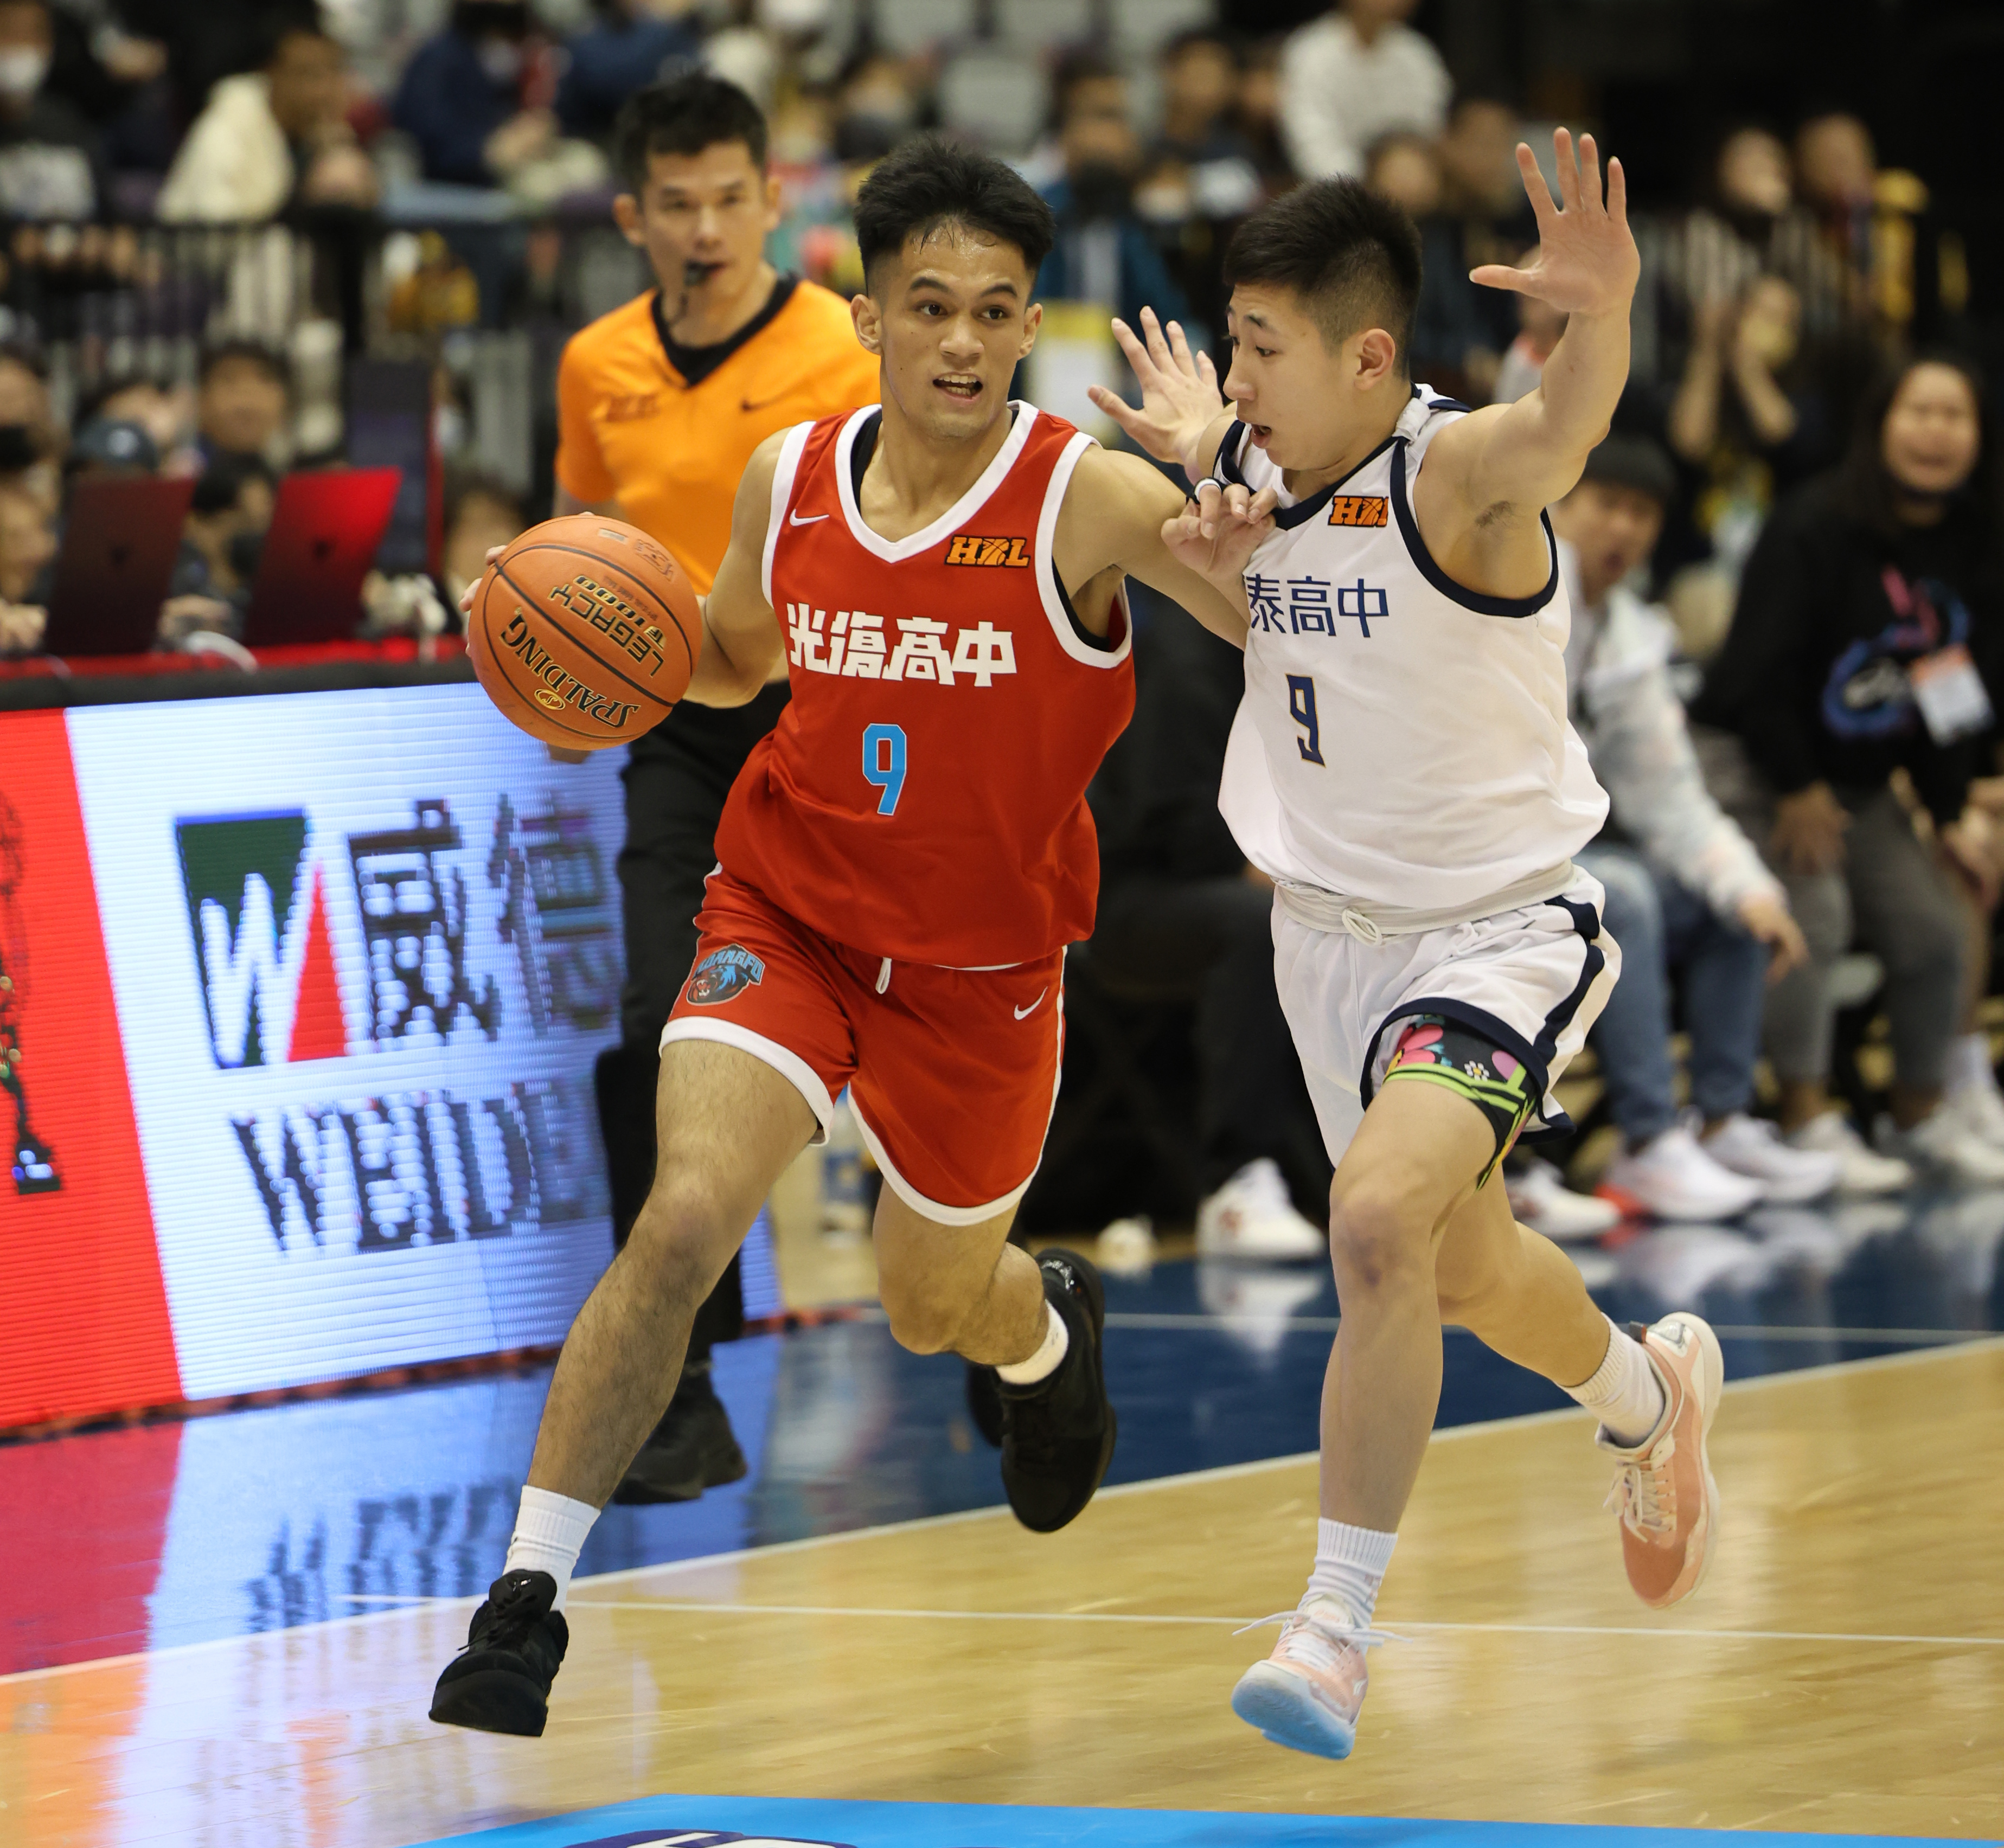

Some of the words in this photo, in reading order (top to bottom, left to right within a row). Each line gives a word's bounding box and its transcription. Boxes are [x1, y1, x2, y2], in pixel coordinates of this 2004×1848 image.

[945, 534, 1031, 568] HBL
[547, 584, 665, 678] LEGACY
[786, 602, 1017, 688] 光復高中
[1243, 573, 1390, 638] 泰高中
[498, 613, 641, 728] SPALDING
[1284, 673, 1327, 768] 9
[862, 722, 907, 816] 9
[230, 1079, 603, 1255] WEIDE
